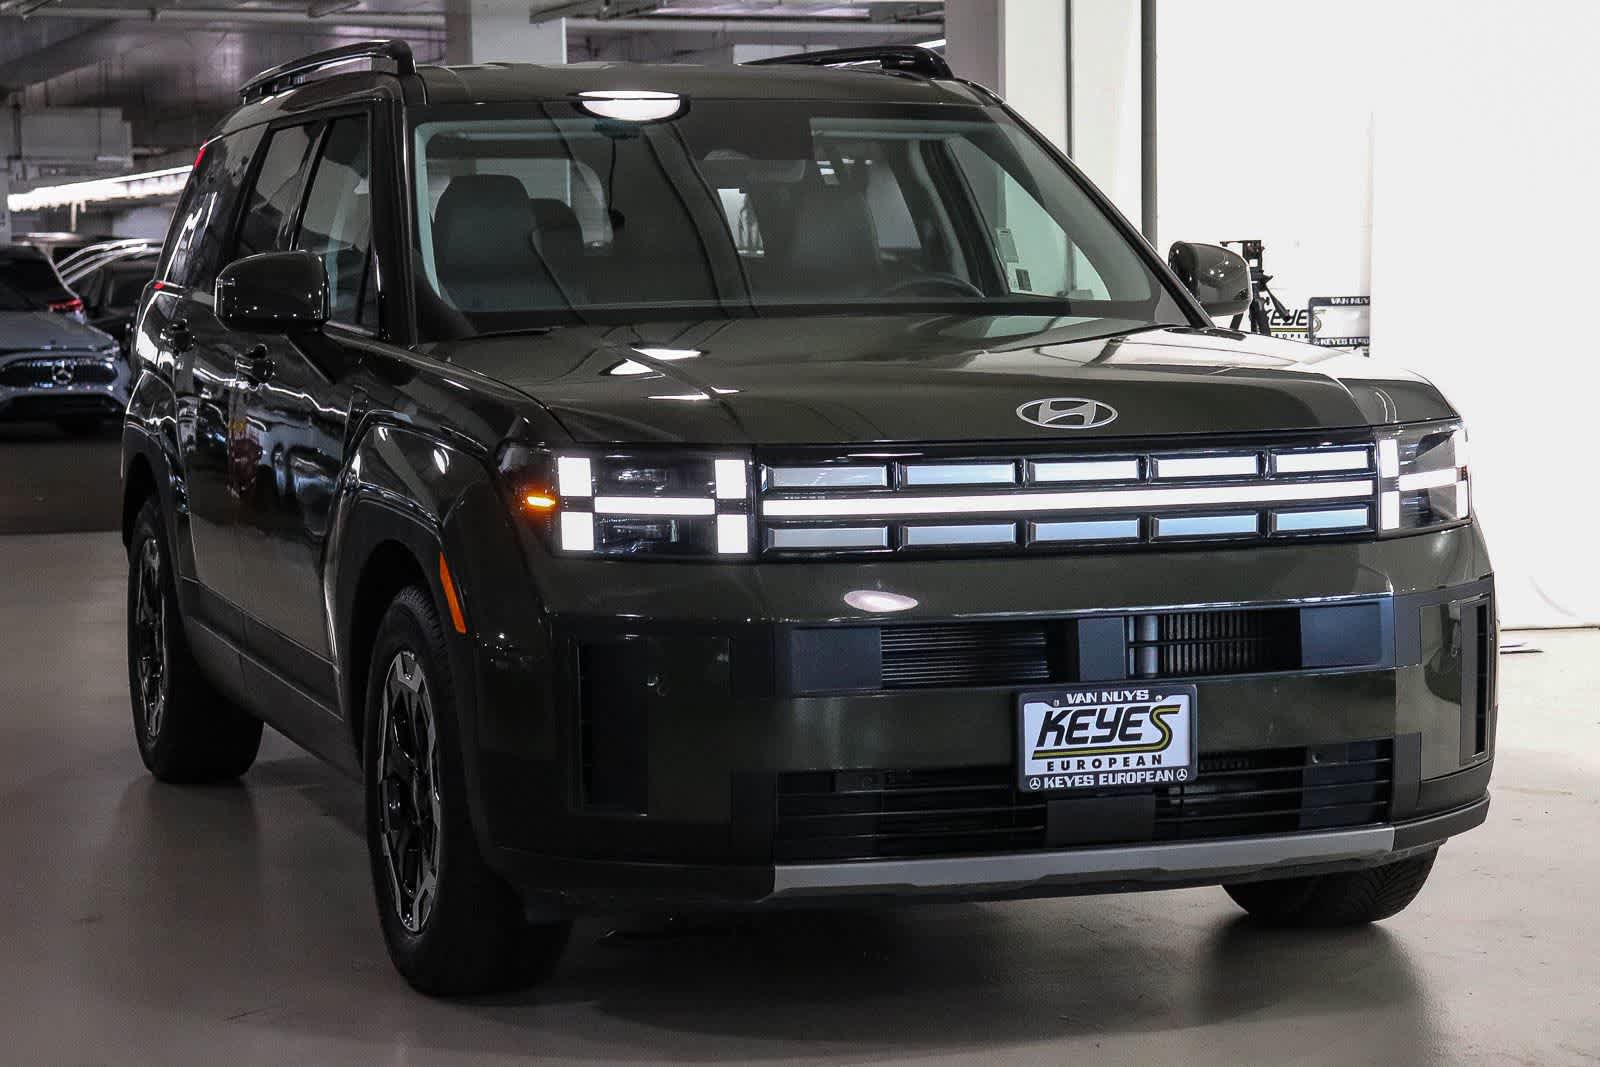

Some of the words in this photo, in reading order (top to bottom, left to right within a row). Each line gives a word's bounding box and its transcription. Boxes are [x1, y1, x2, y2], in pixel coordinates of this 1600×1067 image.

[1066, 692, 1098, 705] VAN
[1102, 689, 1149, 703] NUYS
[1035, 704, 1182, 755] KEYES
[1047, 754, 1162, 772] EUROPEAN
[1044, 774, 1095, 789] KEYES
[1099, 770, 1174, 785] EUROPEAN
